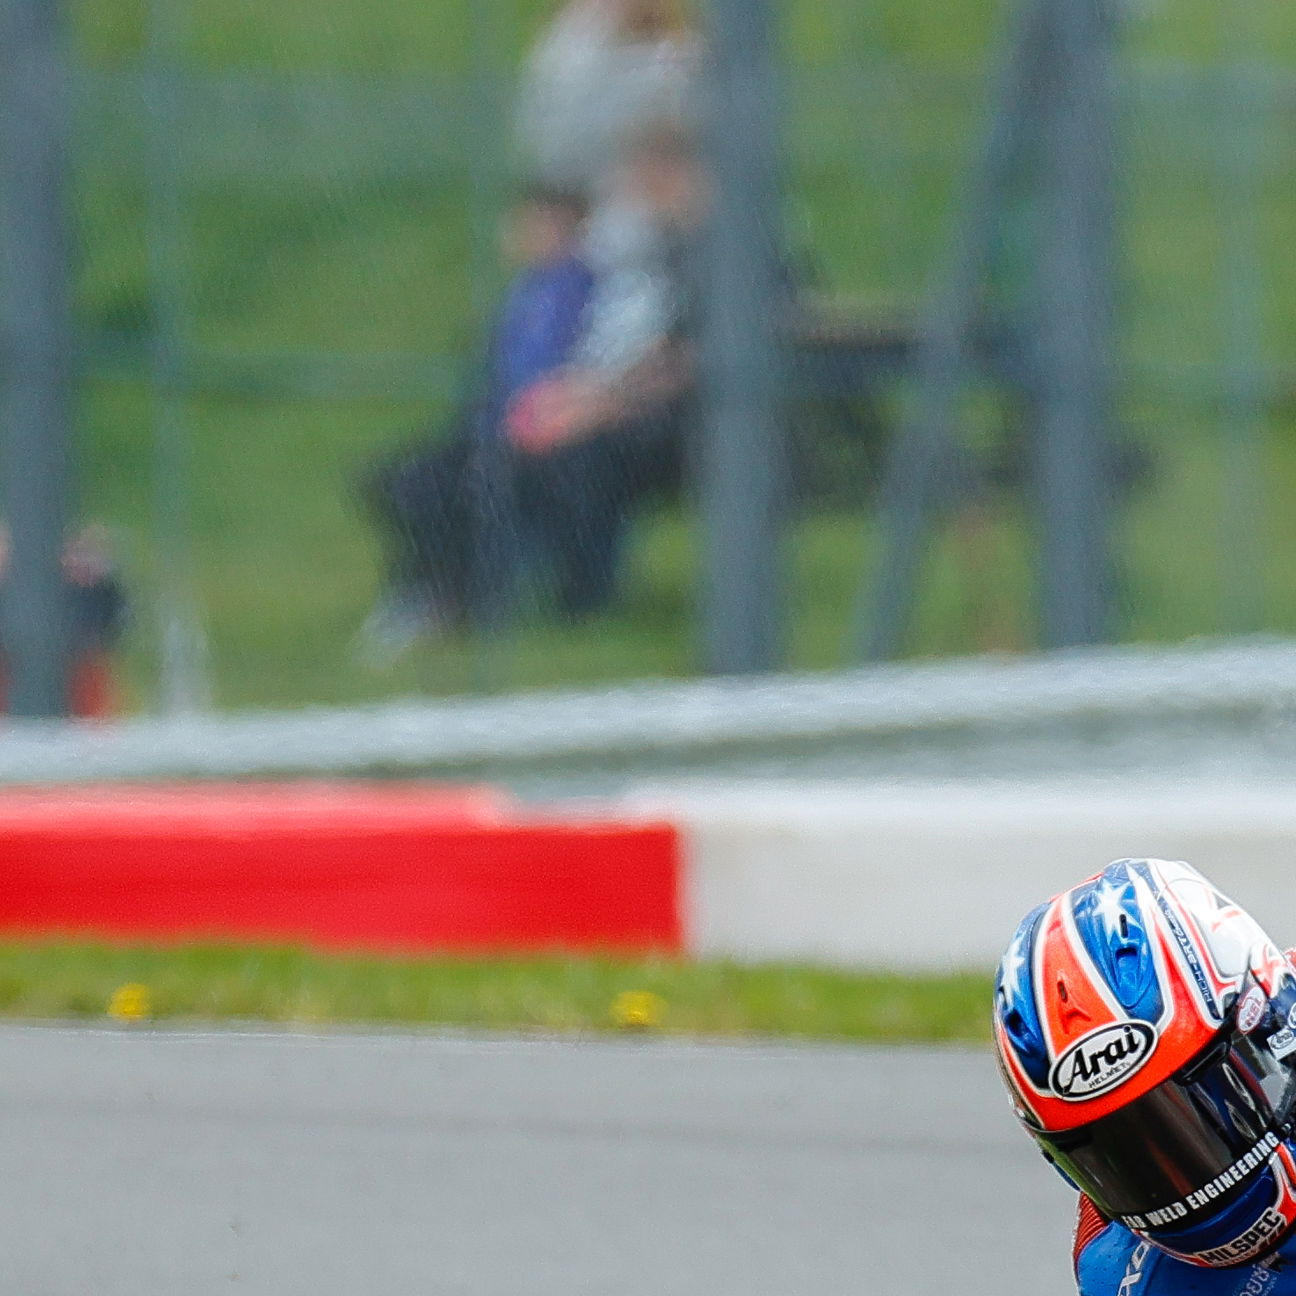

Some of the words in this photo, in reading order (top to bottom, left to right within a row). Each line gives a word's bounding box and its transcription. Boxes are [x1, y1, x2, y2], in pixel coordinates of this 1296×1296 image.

[1063, 1025, 1140, 1094] Arai
[1145, 1201, 1188, 1228] WELD
[1186, 1131, 1280, 1210] ENGINEERING
[1199, 1209, 1282, 1265] MILSPEC
